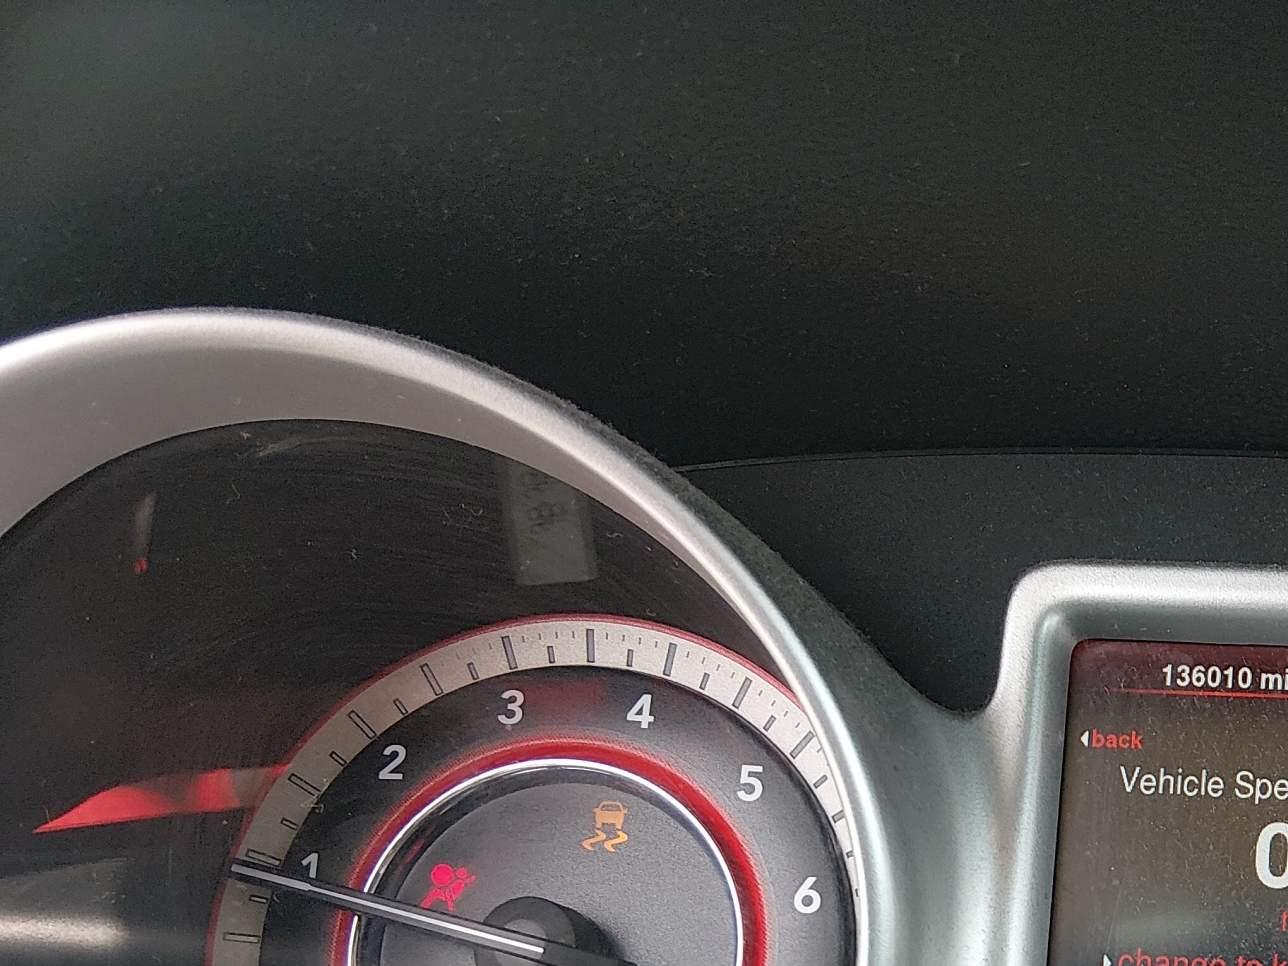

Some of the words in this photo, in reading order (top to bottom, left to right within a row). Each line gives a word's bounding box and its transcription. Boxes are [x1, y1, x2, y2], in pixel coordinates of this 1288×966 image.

[1162, 664, 1252, 690] 136010
[497, 690, 525, 724] 3
[626, 693, 654, 728] 4
[1090, 729, 1143, 749] back
[379, 744, 407, 780] 2
[738, 766, 763, 801] 5
[1121, 766, 1224, 796] Vehicle
[301, 853, 320, 880] 1
[794, 876, 822, 914] 6
